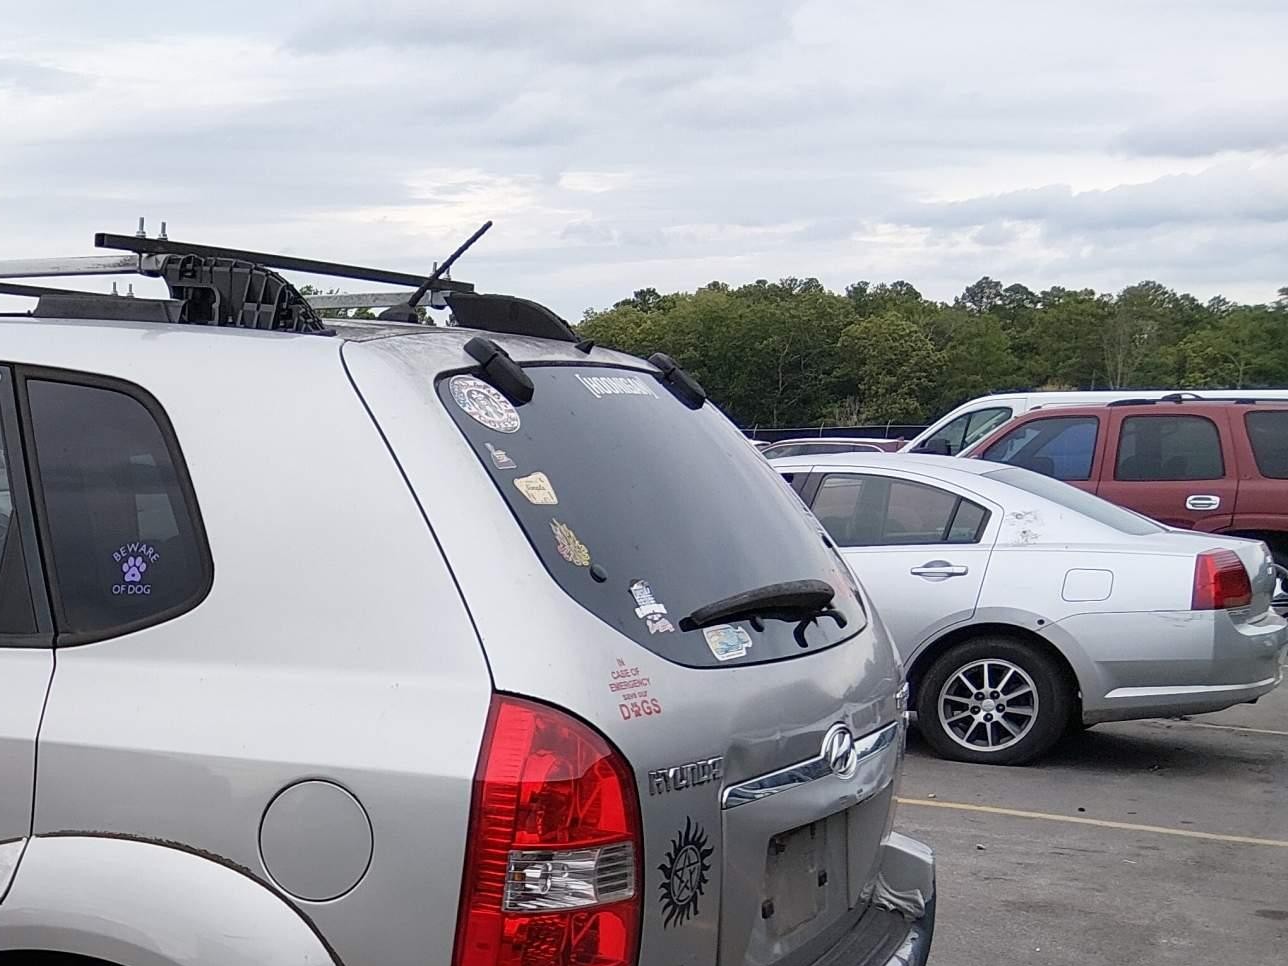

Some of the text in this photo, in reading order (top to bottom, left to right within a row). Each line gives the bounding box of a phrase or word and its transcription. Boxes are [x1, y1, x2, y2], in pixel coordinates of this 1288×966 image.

[112, 542, 160, 563] BEWARE
[112, 584, 152, 594] OF DOG
[608, 677, 651, 693] EMERGENCY
